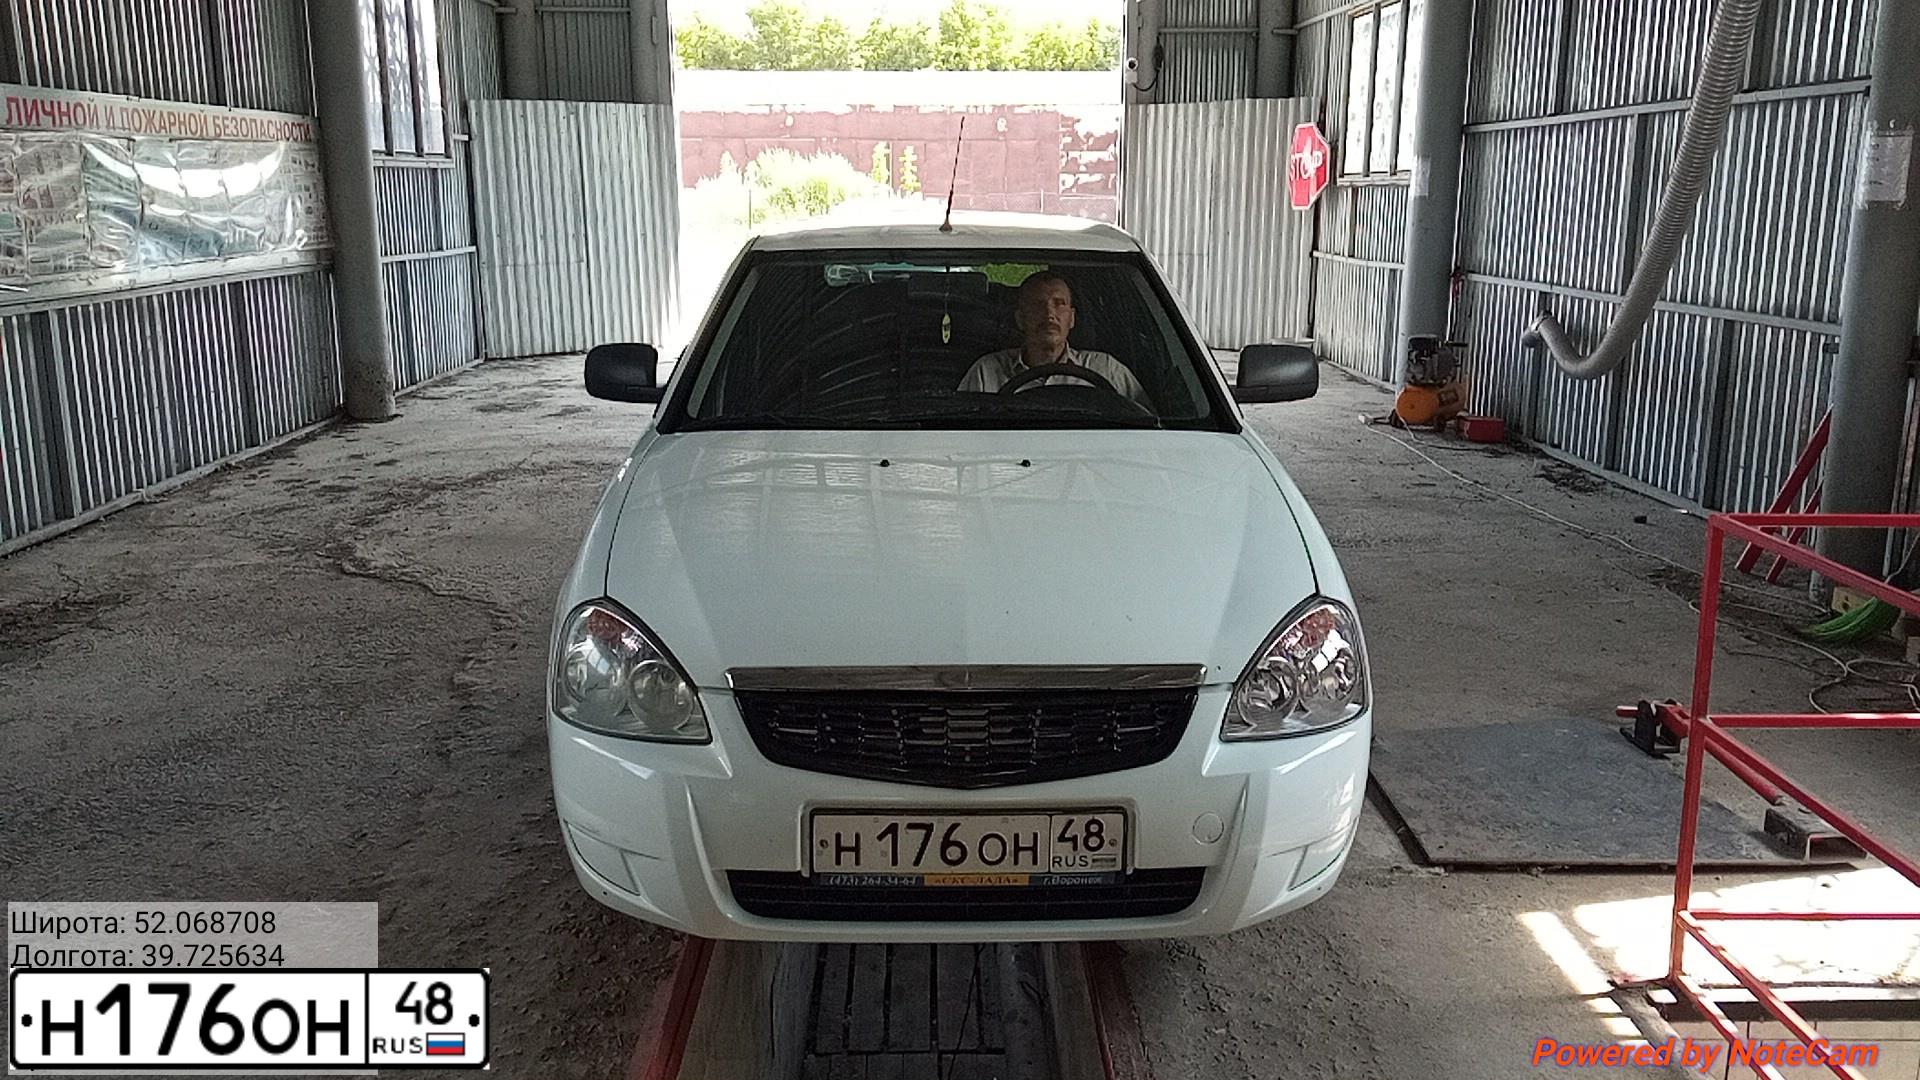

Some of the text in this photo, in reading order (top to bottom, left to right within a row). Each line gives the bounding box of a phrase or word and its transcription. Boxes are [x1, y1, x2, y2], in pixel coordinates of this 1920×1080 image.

[6, 96, 99, 130] ЛИЧНОЙ
[104, 105, 115, 131] И
[212, 115, 312, 143] БЕЗОПАСНОСТИ
[1056, 818, 1107, 853] 48
[1051, 854, 1090, 869] RUS
